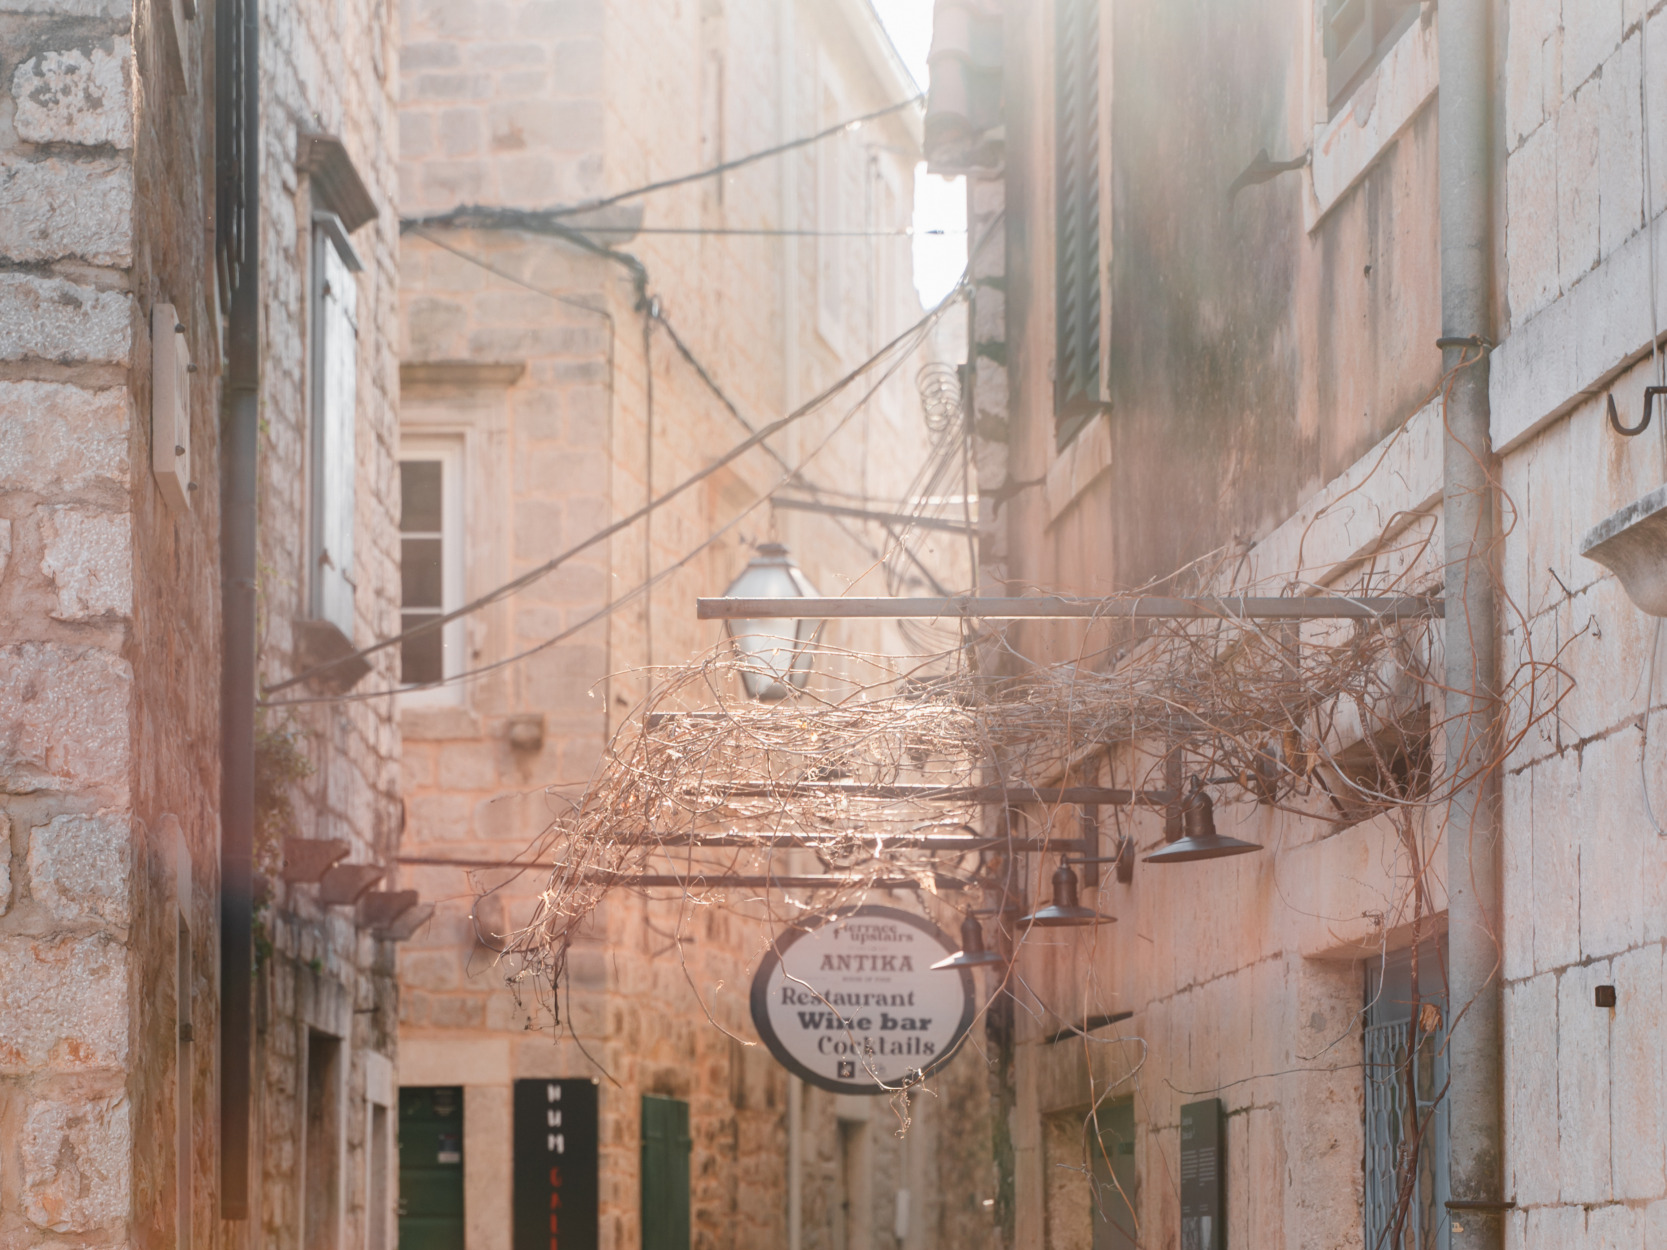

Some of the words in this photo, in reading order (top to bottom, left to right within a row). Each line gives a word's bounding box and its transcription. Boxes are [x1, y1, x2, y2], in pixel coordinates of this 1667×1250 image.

[843, 923, 897, 934] terrace
[850, 931, 914, 945] upstairs
[819, 953, 914, 972] ANTIKA
[781, 986, 915, 1007] Restaurant
[797, 1011, 872, 1031] Wine
[880, 1012, 933, 1031] bar
[817, 1035, 936, 1056] Cocktails
